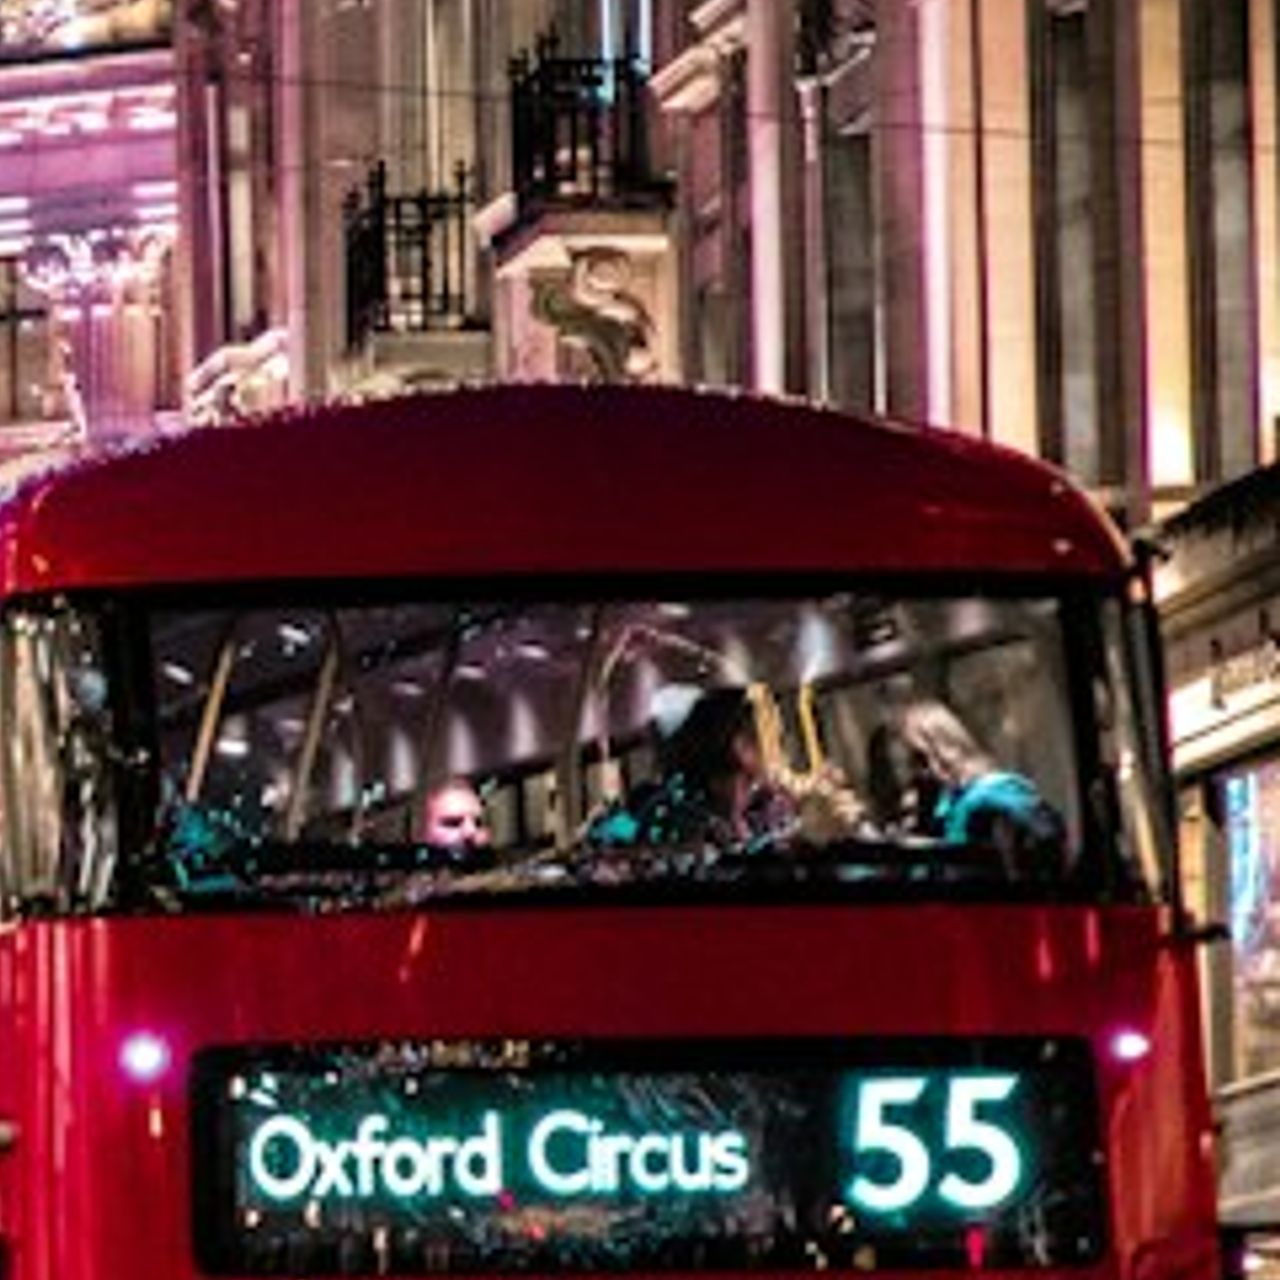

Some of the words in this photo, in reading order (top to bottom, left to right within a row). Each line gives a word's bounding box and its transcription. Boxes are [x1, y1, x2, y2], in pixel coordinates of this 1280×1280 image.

[249, 1109, 503, 1199] Oxford
[527, 1108, 749, 1194] Circus
[846, 1076, 1022, 1211] 55
